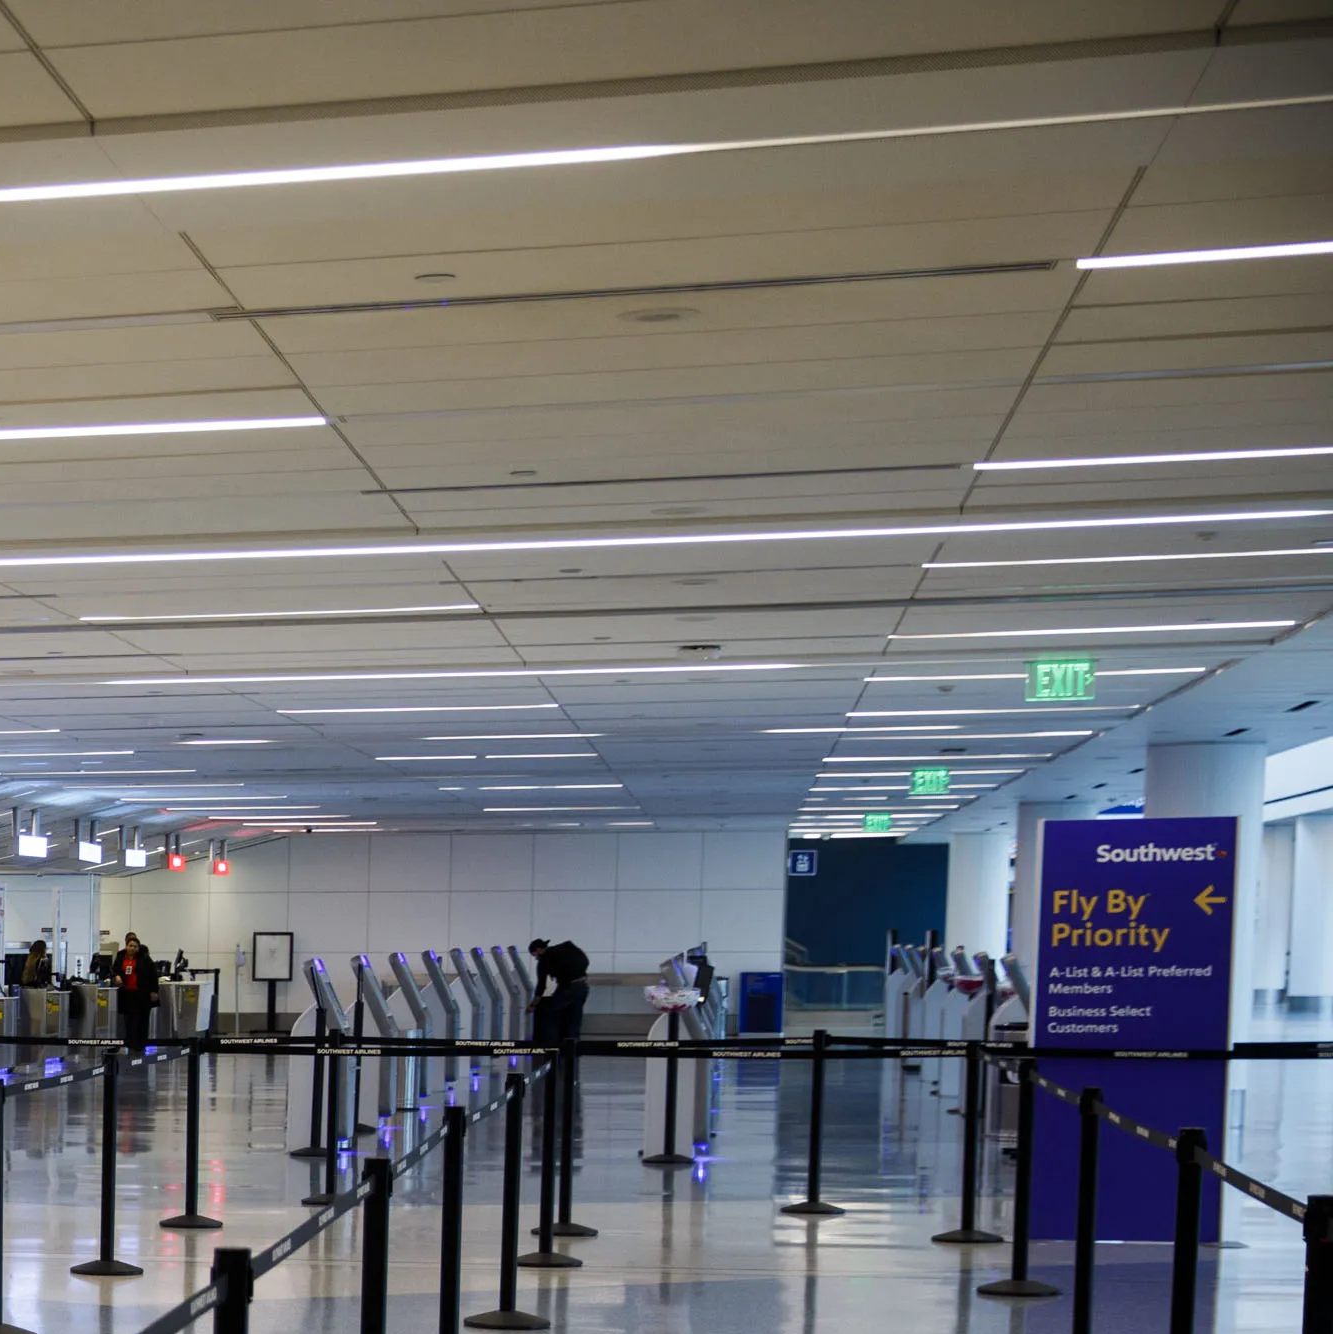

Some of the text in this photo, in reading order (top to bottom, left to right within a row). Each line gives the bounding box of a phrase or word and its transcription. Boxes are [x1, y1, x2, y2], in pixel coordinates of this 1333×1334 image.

[1036, 663, 1090, 697] EXIT
[913, 769, 949, 791] EXIT
[1096, 842, 1216, 863] Southwest
[1052, 889, 1146, 921] Fly By
[1051, 921, 1171, 953] Priority
[1049, 964, 1212, 978] A-List & A-List Preferred
[1048, 982, 1113, 995] Members
[1048, 1004, 1151, 1018] Business Select
[1047, 1022, 1119, 1034] Customers
